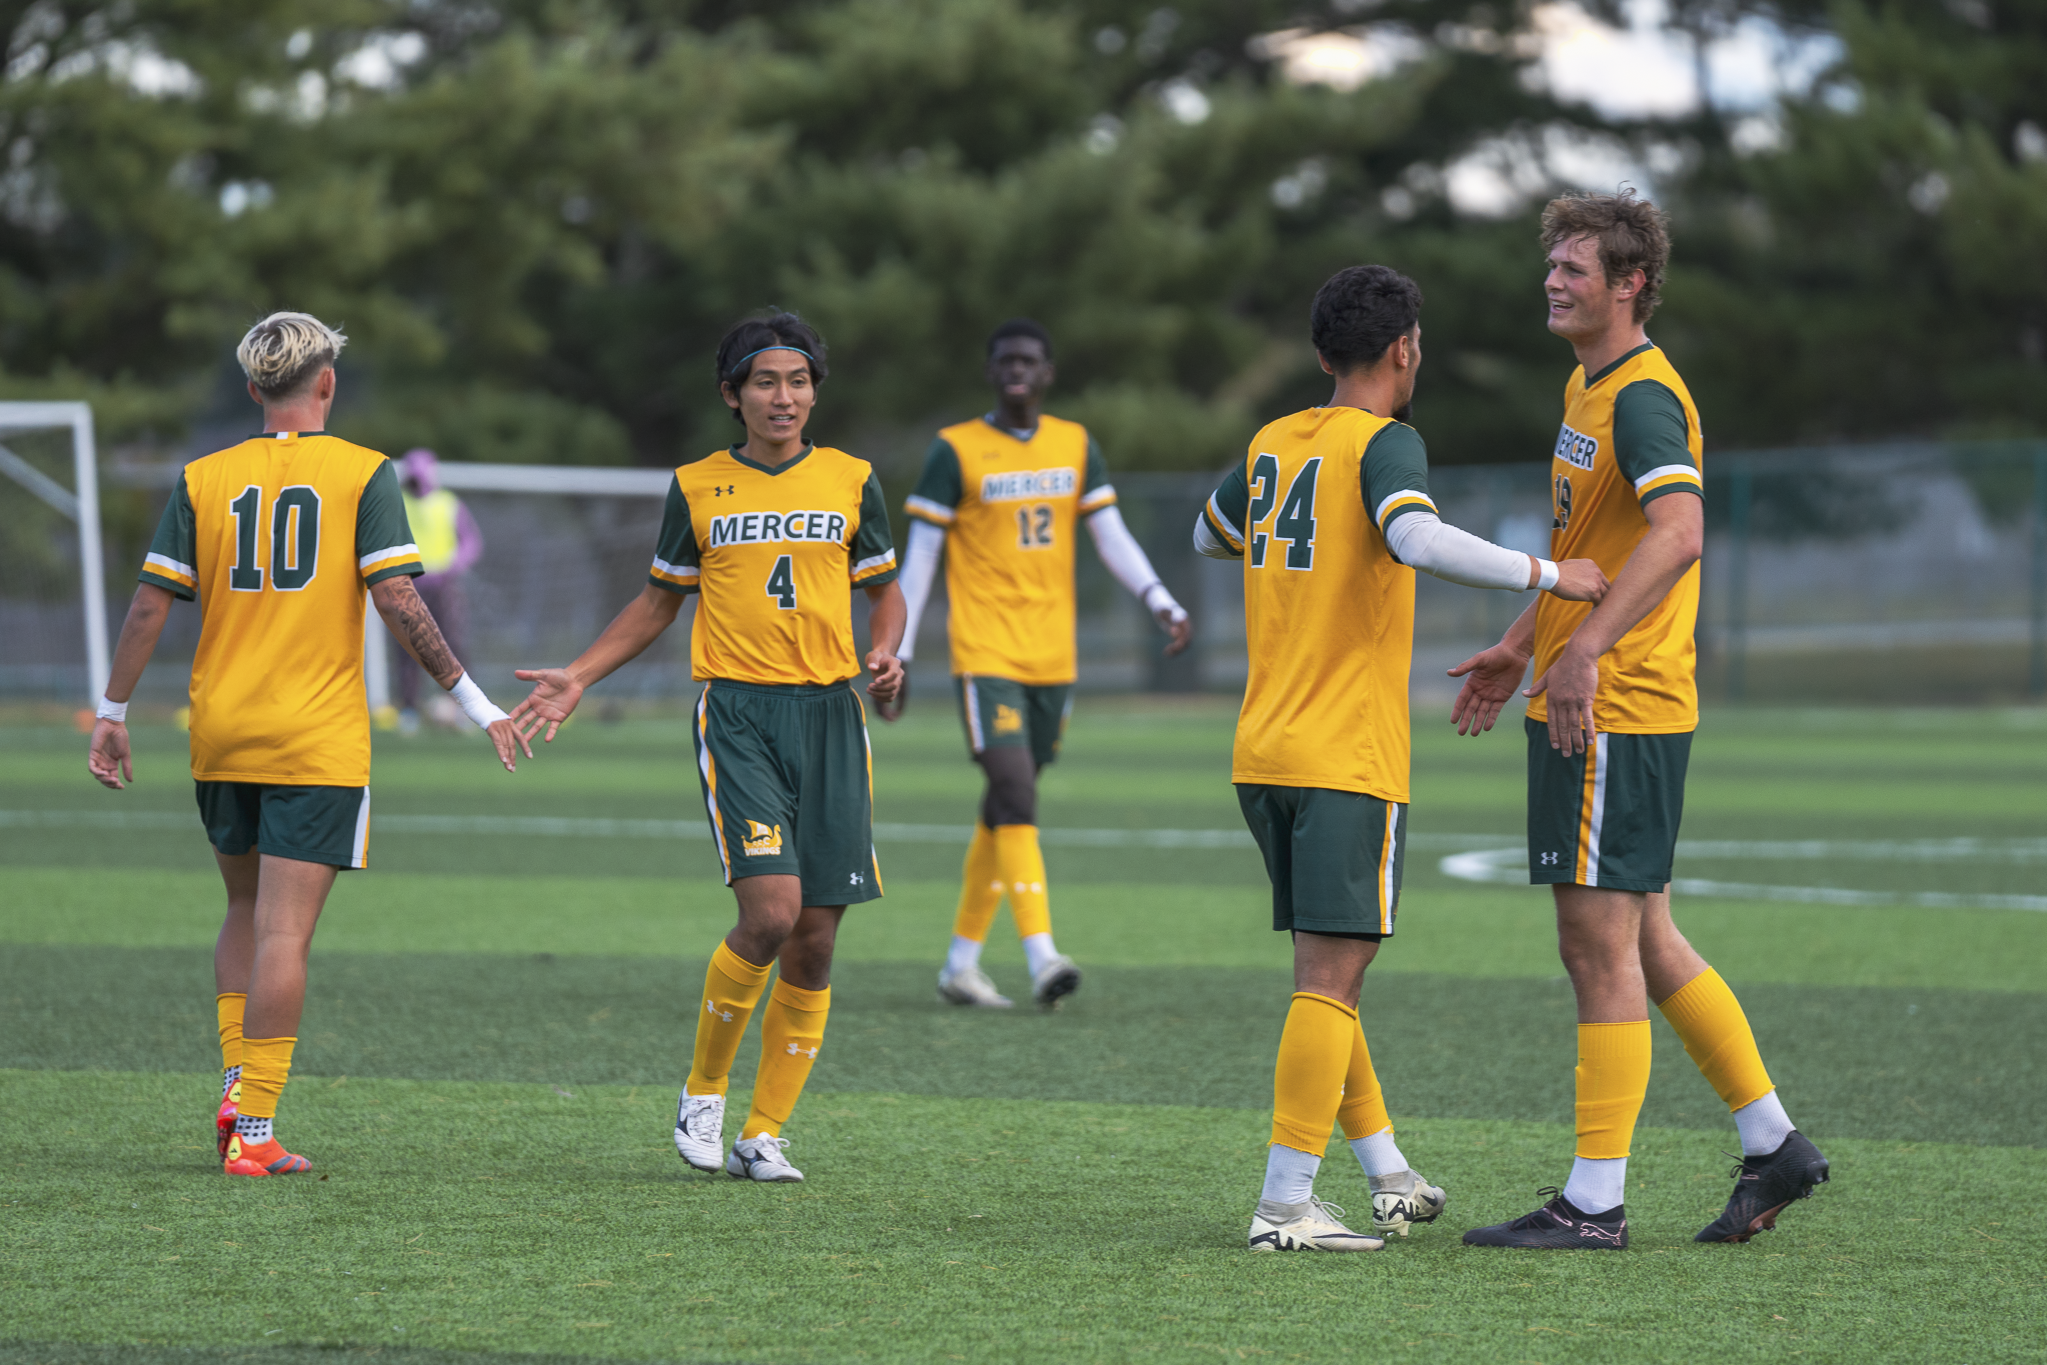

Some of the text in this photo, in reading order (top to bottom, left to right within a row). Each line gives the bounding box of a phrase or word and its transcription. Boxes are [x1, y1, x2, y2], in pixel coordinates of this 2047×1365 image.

[1554, 422, 1599, 472] ERCER
[710, 510, 847, 548] MERCER
[1014, 503, 1056, 551] 12
[1250, 452, 1324, 571] 24
[229, 484, 322, 592] 10
[765, 554, 797, 610] 4
[744, 846, 781, 857] VIKINGS
